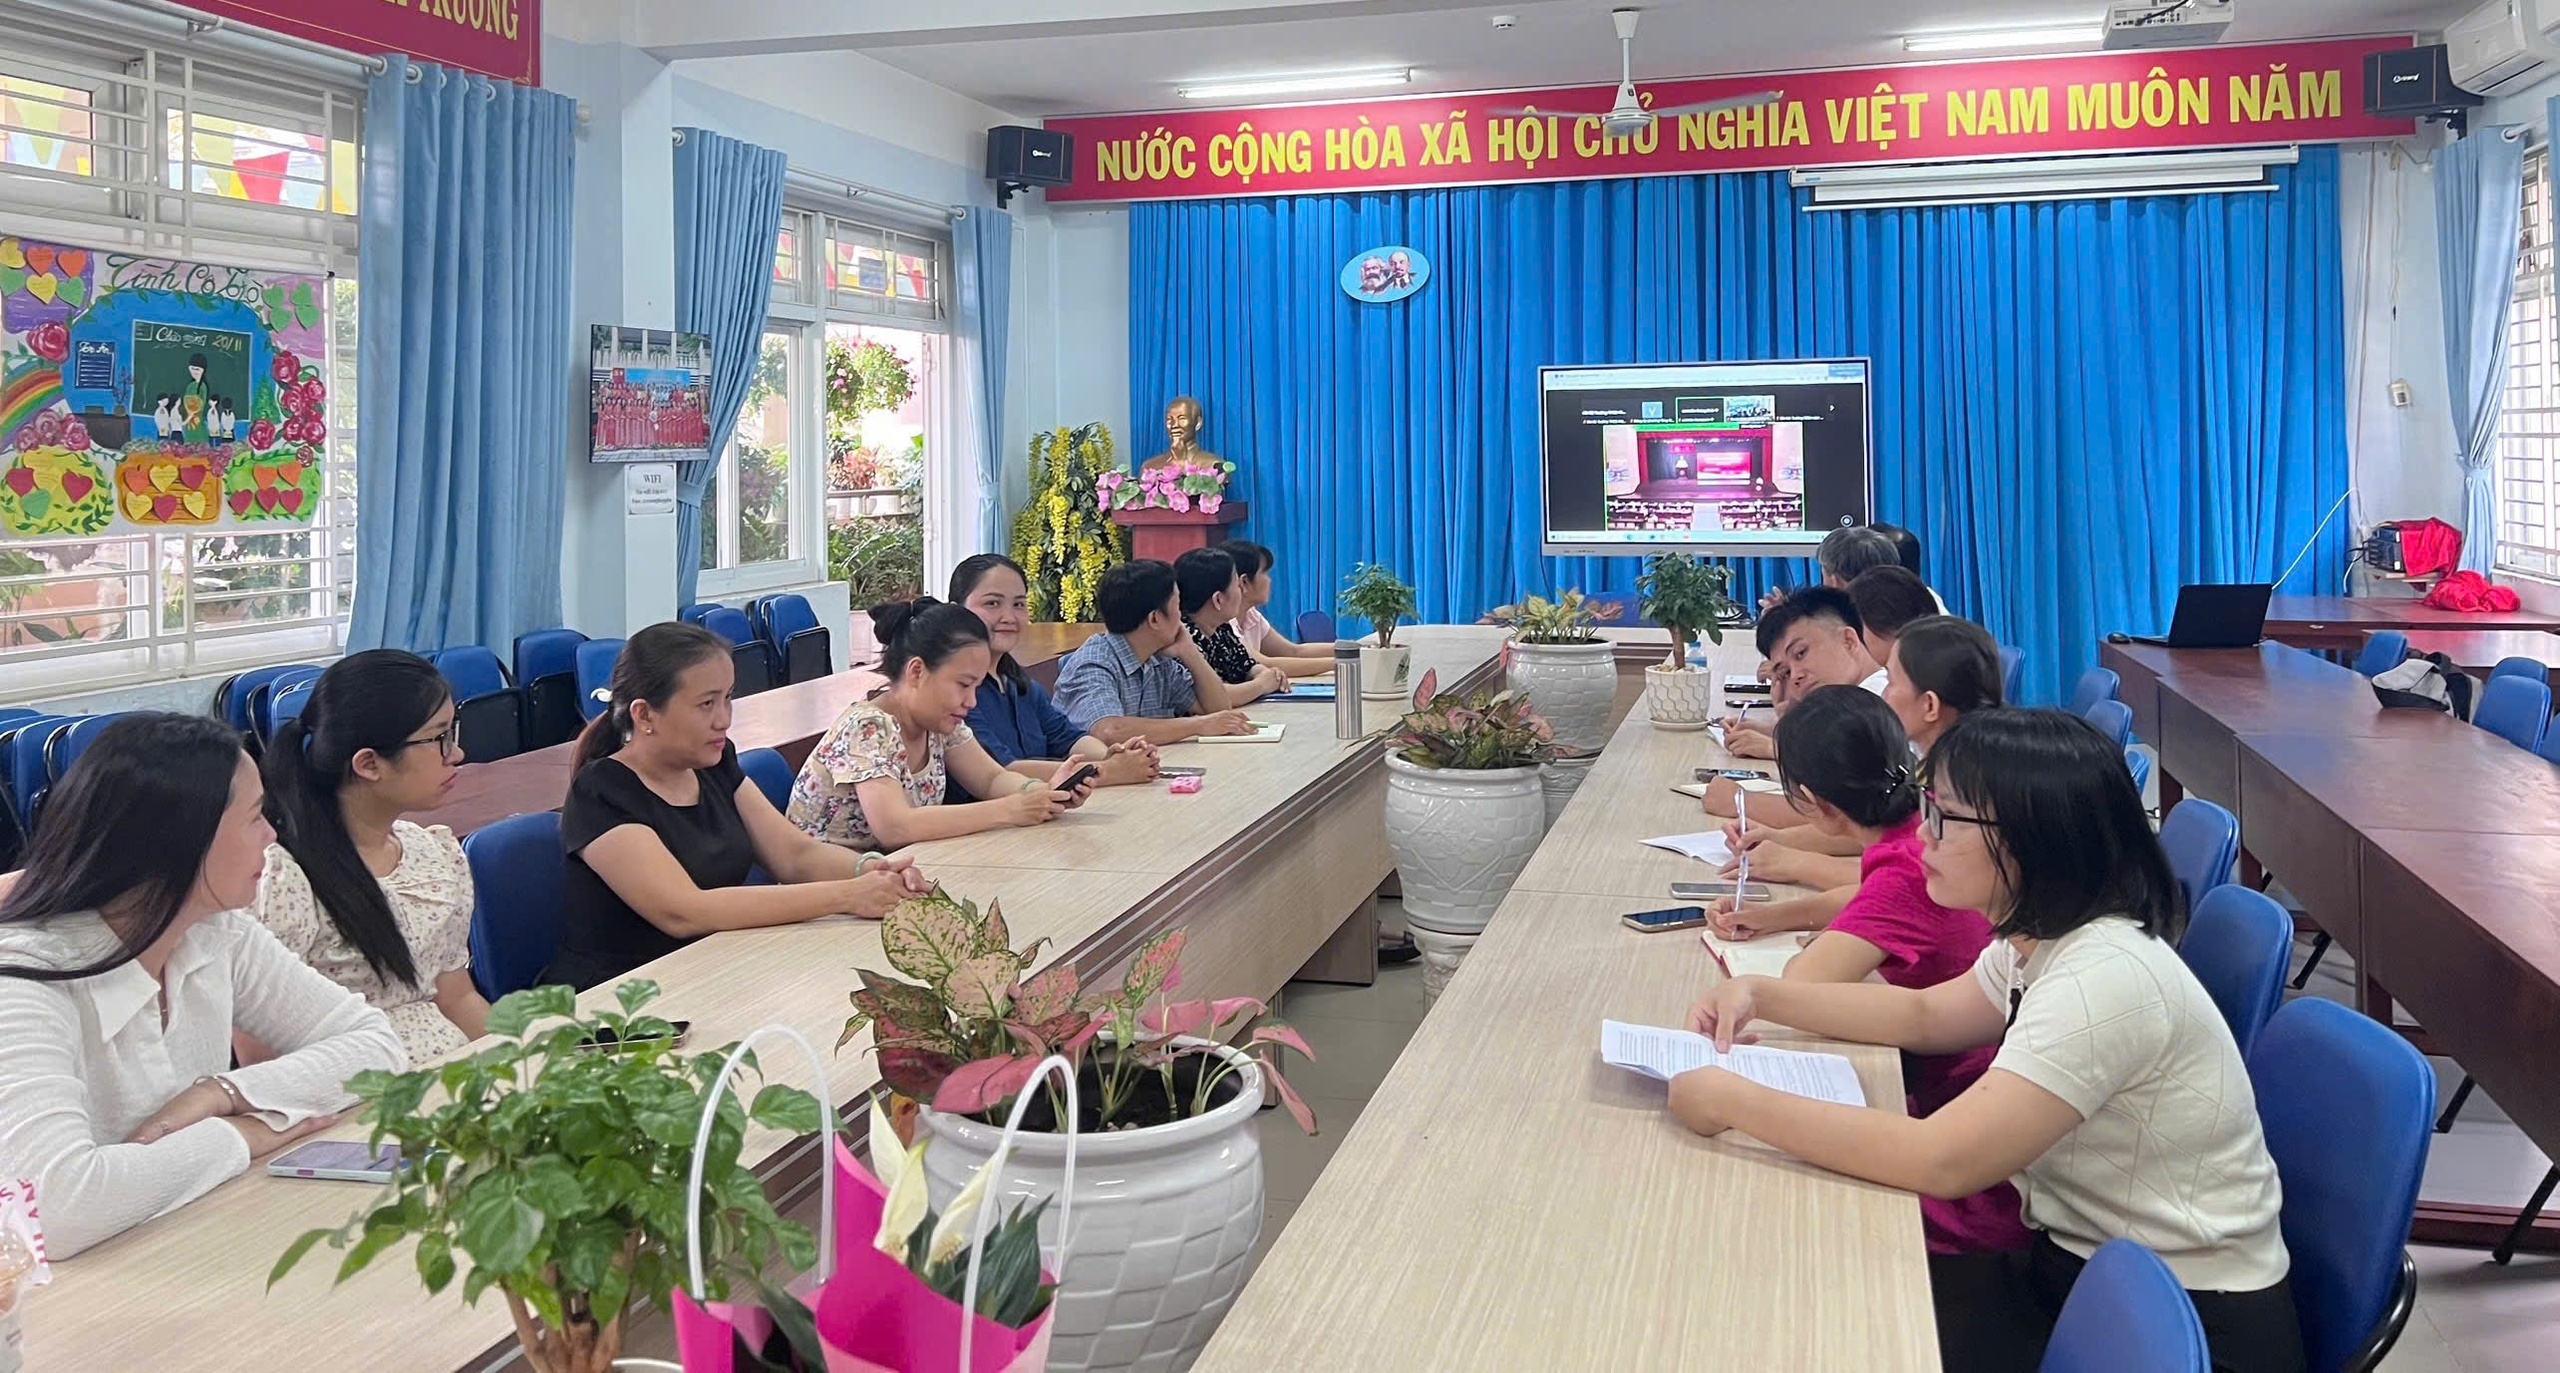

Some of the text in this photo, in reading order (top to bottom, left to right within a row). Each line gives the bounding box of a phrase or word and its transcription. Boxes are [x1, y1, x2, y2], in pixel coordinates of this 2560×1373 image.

[1096, 127, 1197, 182] NƯỚC
[1208, 121, 1312, 184] CỘNG
[1324, 115, 1407, 172] HÒA
[1418, 109, 1472, 167] XÃ
[1488, 105, 1568, 170] HỘI
[1824, 82, 1929, 151] VIỆT
[1946, 86, 2049, 137] NAM
[2067, 66, 2210, 132] MUÔN
[2229, 62, 2341, 123] NĂM
[212, 334, 242, 352] 20/11
